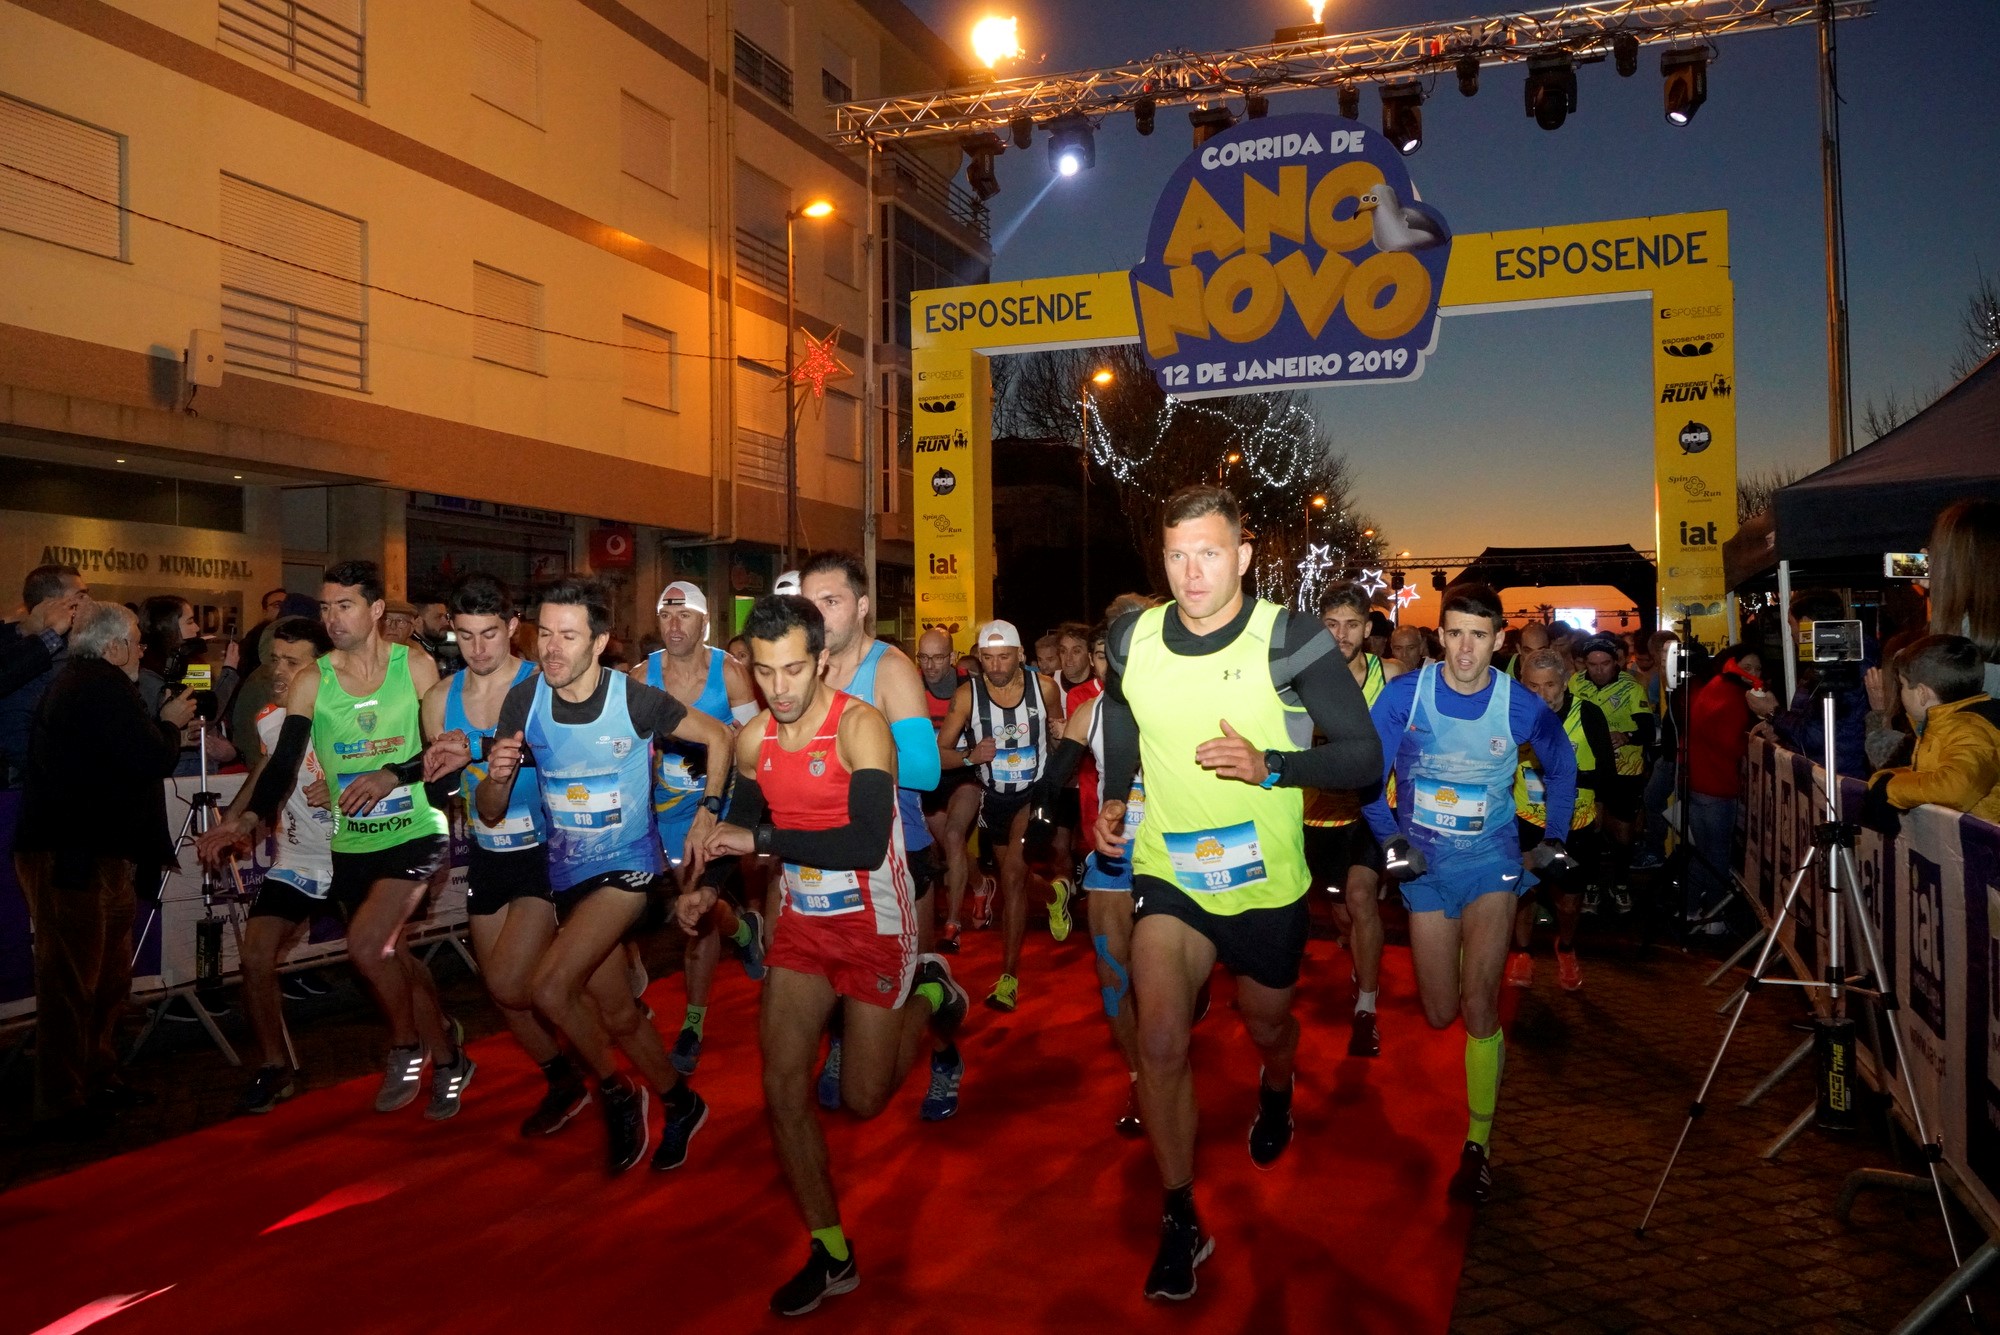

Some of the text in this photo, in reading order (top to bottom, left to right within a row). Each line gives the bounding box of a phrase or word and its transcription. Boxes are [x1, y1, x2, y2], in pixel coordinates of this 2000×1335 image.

[1201, 129, 1365, 172] CORRIDA DE
[1163, 160, 1386, 267] ANO
[1495, 230, 1708, 282] ESPOSENDE
[926, 290, 1092, 334] ESPOSENDE
[1137, 250, 1432, 360] NOVO
[1662, 332, 1725, 346] esposende 2000
[1162, 348, 1409, 388] 12 DE JANEIRO 2019
[1665, 380, 1709, 389] ESPOSENDE
[918, 395, 950, 403] esposende
[1661, 386, 1708, 403] RUN
[916, 438, 950, 453] RUN
[1668, 475, 1688, 484] Spin
[923, 513, 938, 521] Spin
[1679, 520, 1717, 546] iat
[41, 545, 253, 579] AUDITÓRIO MUNICIPAL
[929, 553, 958, 576] iat
[1668, 566, 1724, 578] ESPOSEND
[921, 614, 968, 624] esposende 2000
[1009, 770, 1023, 780] 134
[370, 801, 388, 814] 82
[574, 812, 593, 826] 818
[1435, 813, 1457, 828] 923
[493, 835, 513, 847] 954
[1204, 870, 1232, 888] 328
[1911, 862, 1944, 983] iat
[1829, 1042, 1846, 1112] RACE TIME
